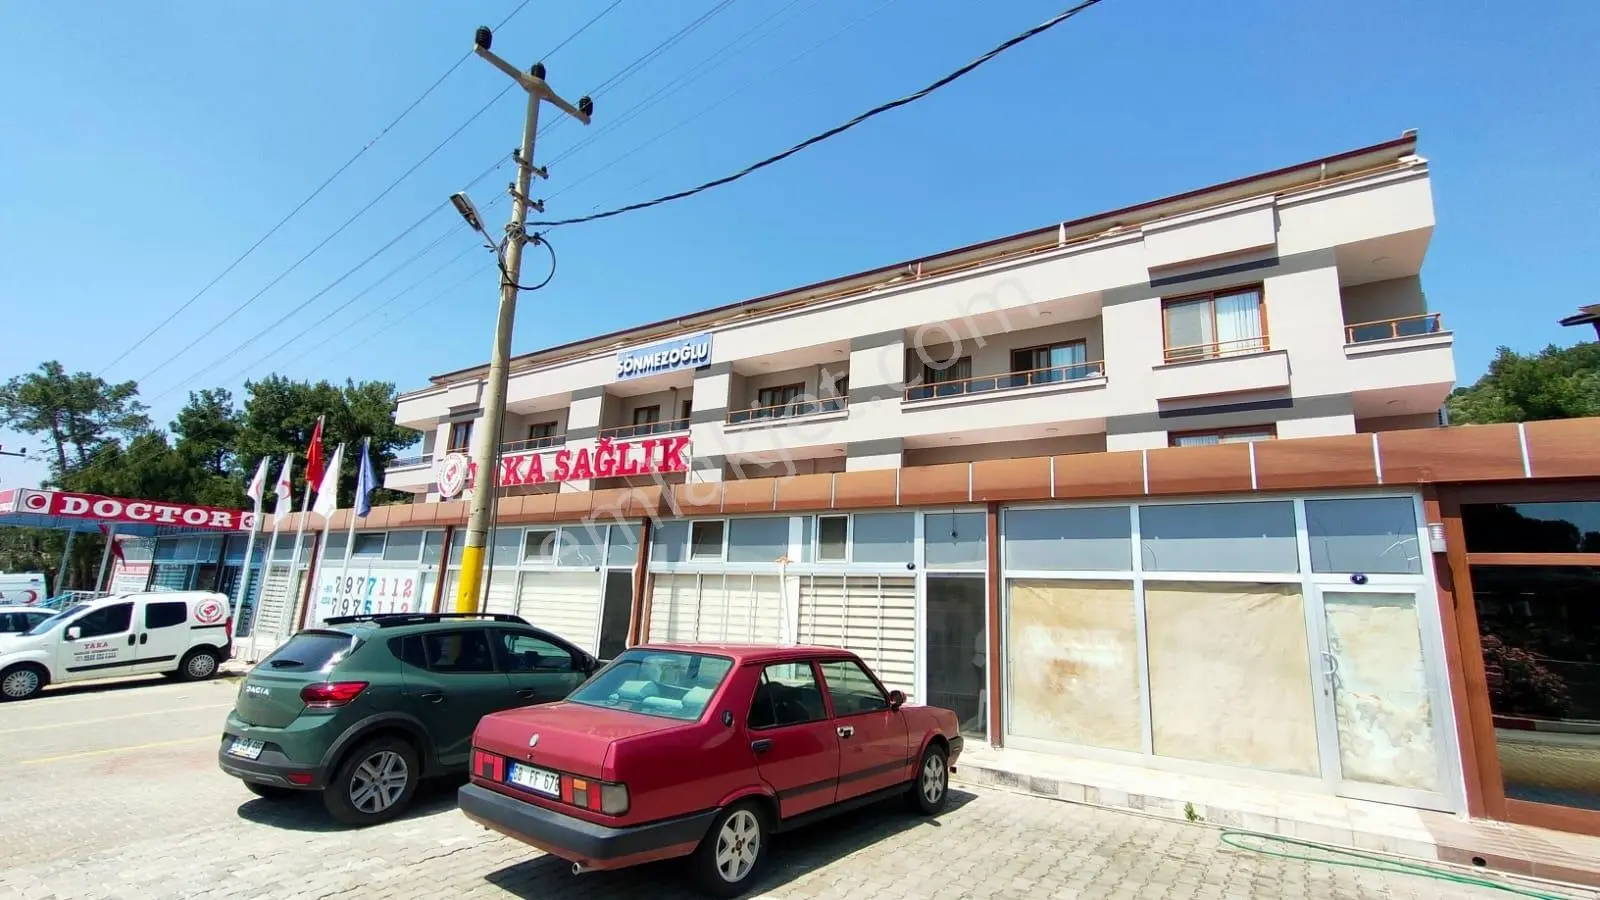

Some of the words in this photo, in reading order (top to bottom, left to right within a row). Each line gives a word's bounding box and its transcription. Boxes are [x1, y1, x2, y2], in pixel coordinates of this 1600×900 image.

[616, 342, 709, 378] SÖNMEZOĞLU
[554, 435, 690, 482] SAĞLIK
[59, 495, 233, 528] DOCTOR
[246, 685, 270, 696] DACIA
[529, 770, 541, 787] FF
